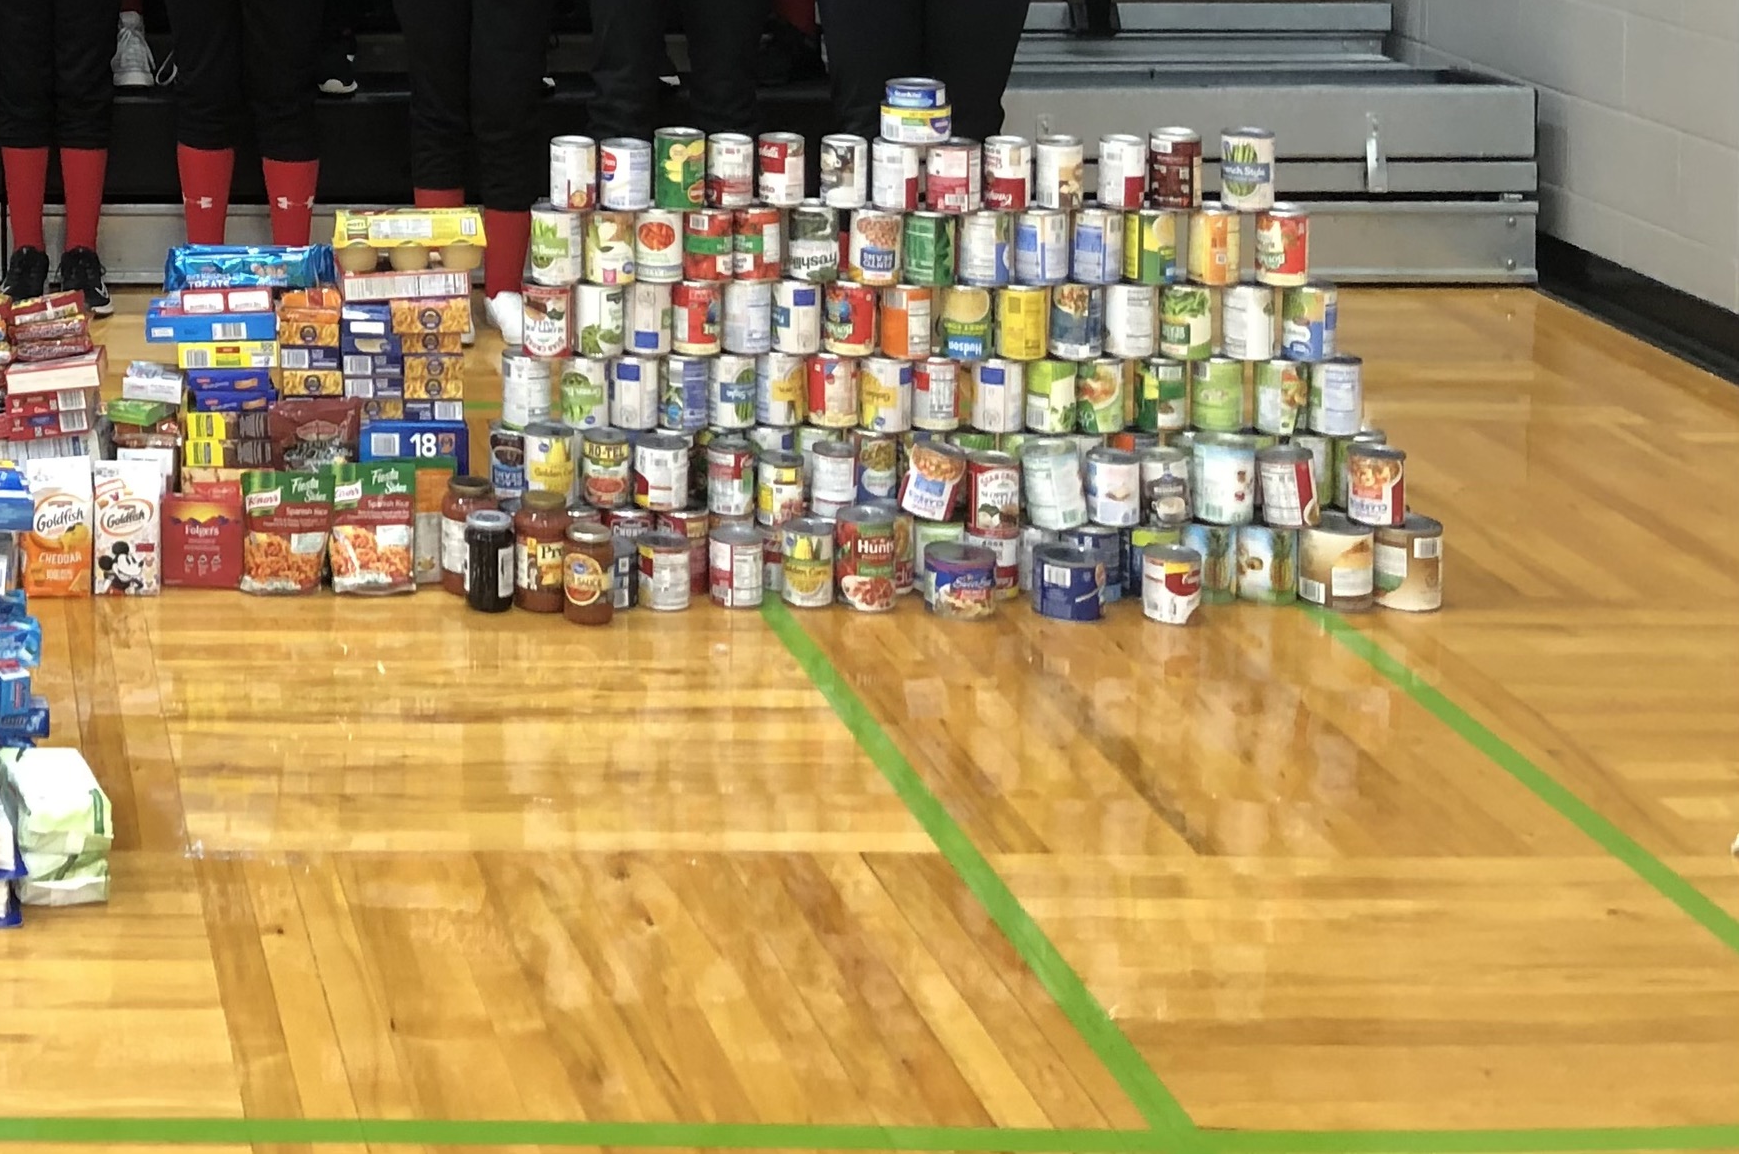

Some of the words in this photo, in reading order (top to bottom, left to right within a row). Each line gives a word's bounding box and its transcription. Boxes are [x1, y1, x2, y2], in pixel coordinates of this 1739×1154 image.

[1244, 167, 1266, 177] Style
[863, 252, 894, 261] BEANS
[863, 260, 894, 270] PINTO
[948, 340, 983, 356] Hudson
[410, 433, 437, 458] 18
[247, 495, 279, 508] Knorr
[37, 507, 84, 533] Goldfish
[107, 509, 146, 529] Goldfish
[185, 523, 220, 538] Folgers
[39, 552, 82, 565] CHEDDAR
